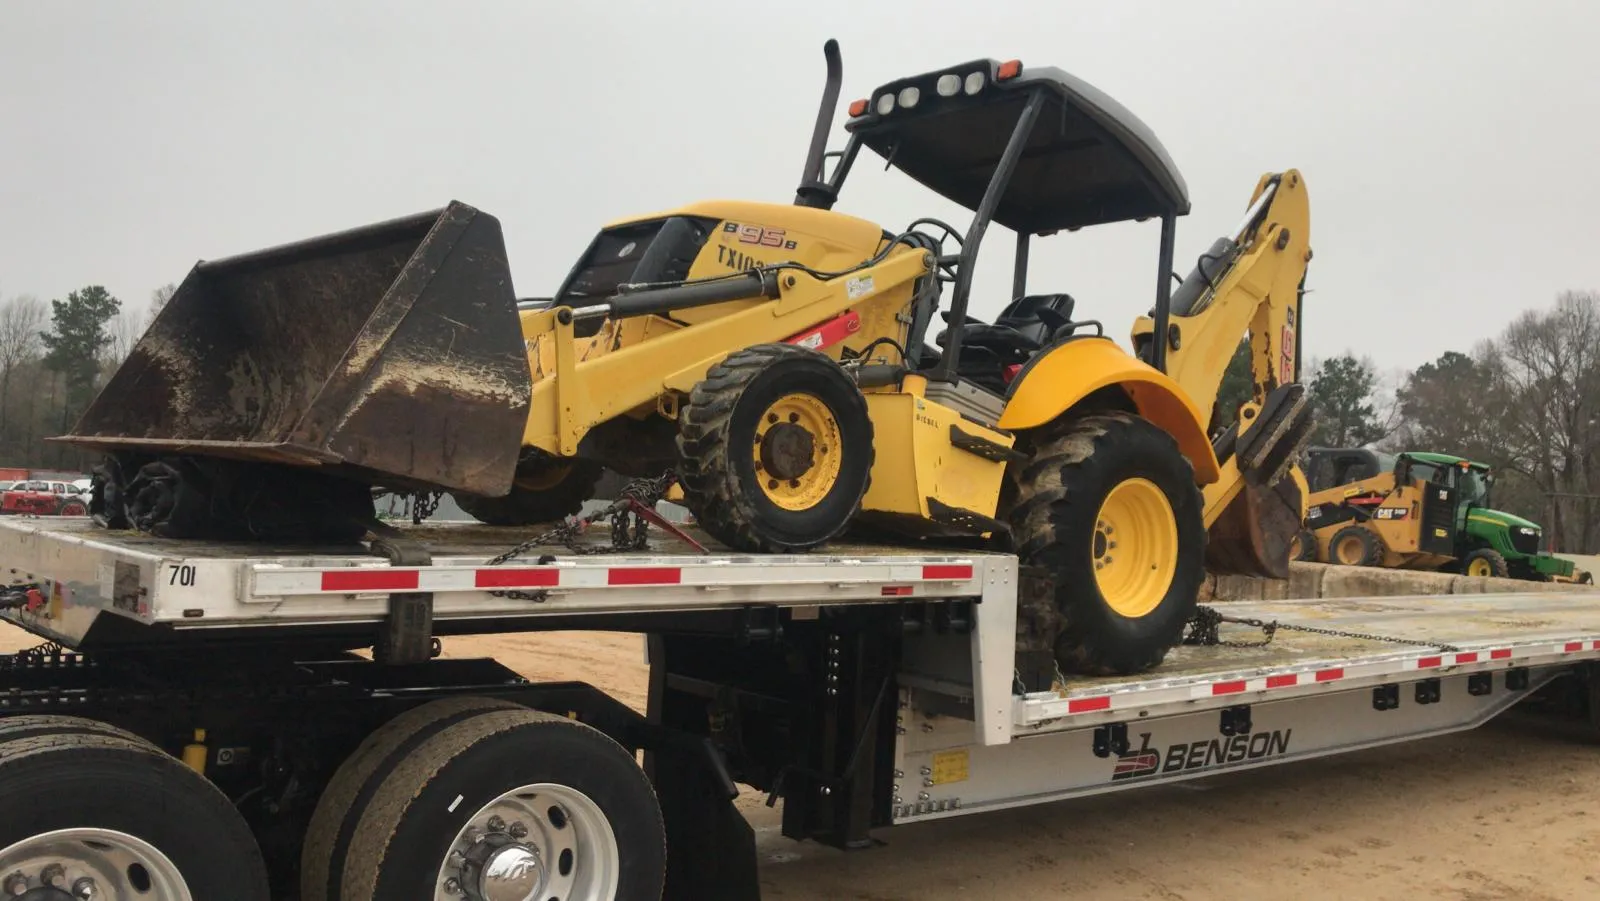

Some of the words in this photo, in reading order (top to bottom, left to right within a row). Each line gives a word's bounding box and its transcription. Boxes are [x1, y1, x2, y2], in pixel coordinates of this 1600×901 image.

[1377, 508, 1394, 519] CAT
[169, 565, 196, 586] 701
[1163, 729, 1292, 773] BENSON
